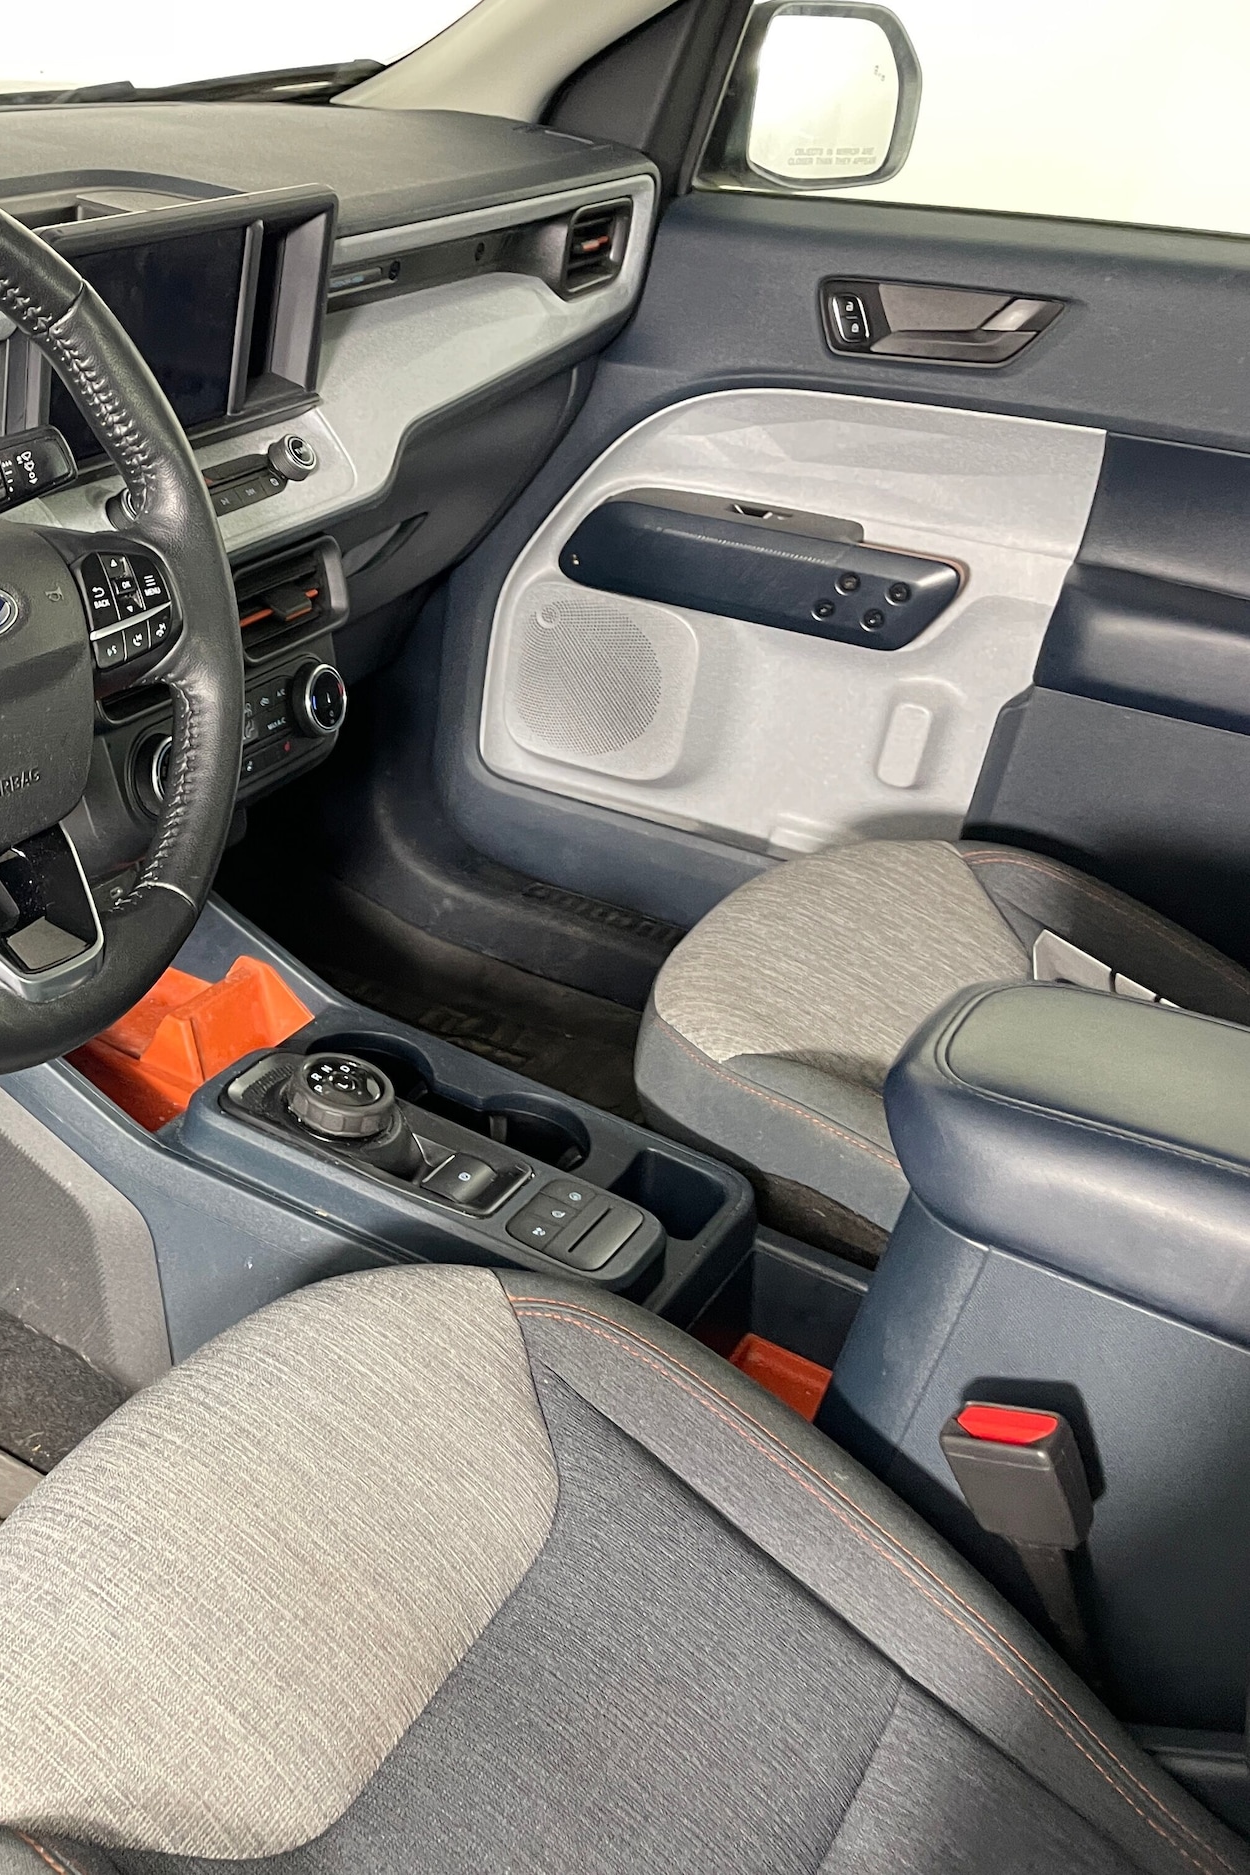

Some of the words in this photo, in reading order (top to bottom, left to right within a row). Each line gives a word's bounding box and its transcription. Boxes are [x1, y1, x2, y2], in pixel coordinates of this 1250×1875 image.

[144, 586, 161, 597] MENU
[93, 598, 111, 610] BACK
[321, 1064, 333, 1073] N
[339, 1064, 351, 1073] D
[310, 1072, 323, 1081] R
[313, 1084, 323, 1093] P
[337, 1082, 349, 1090] L
